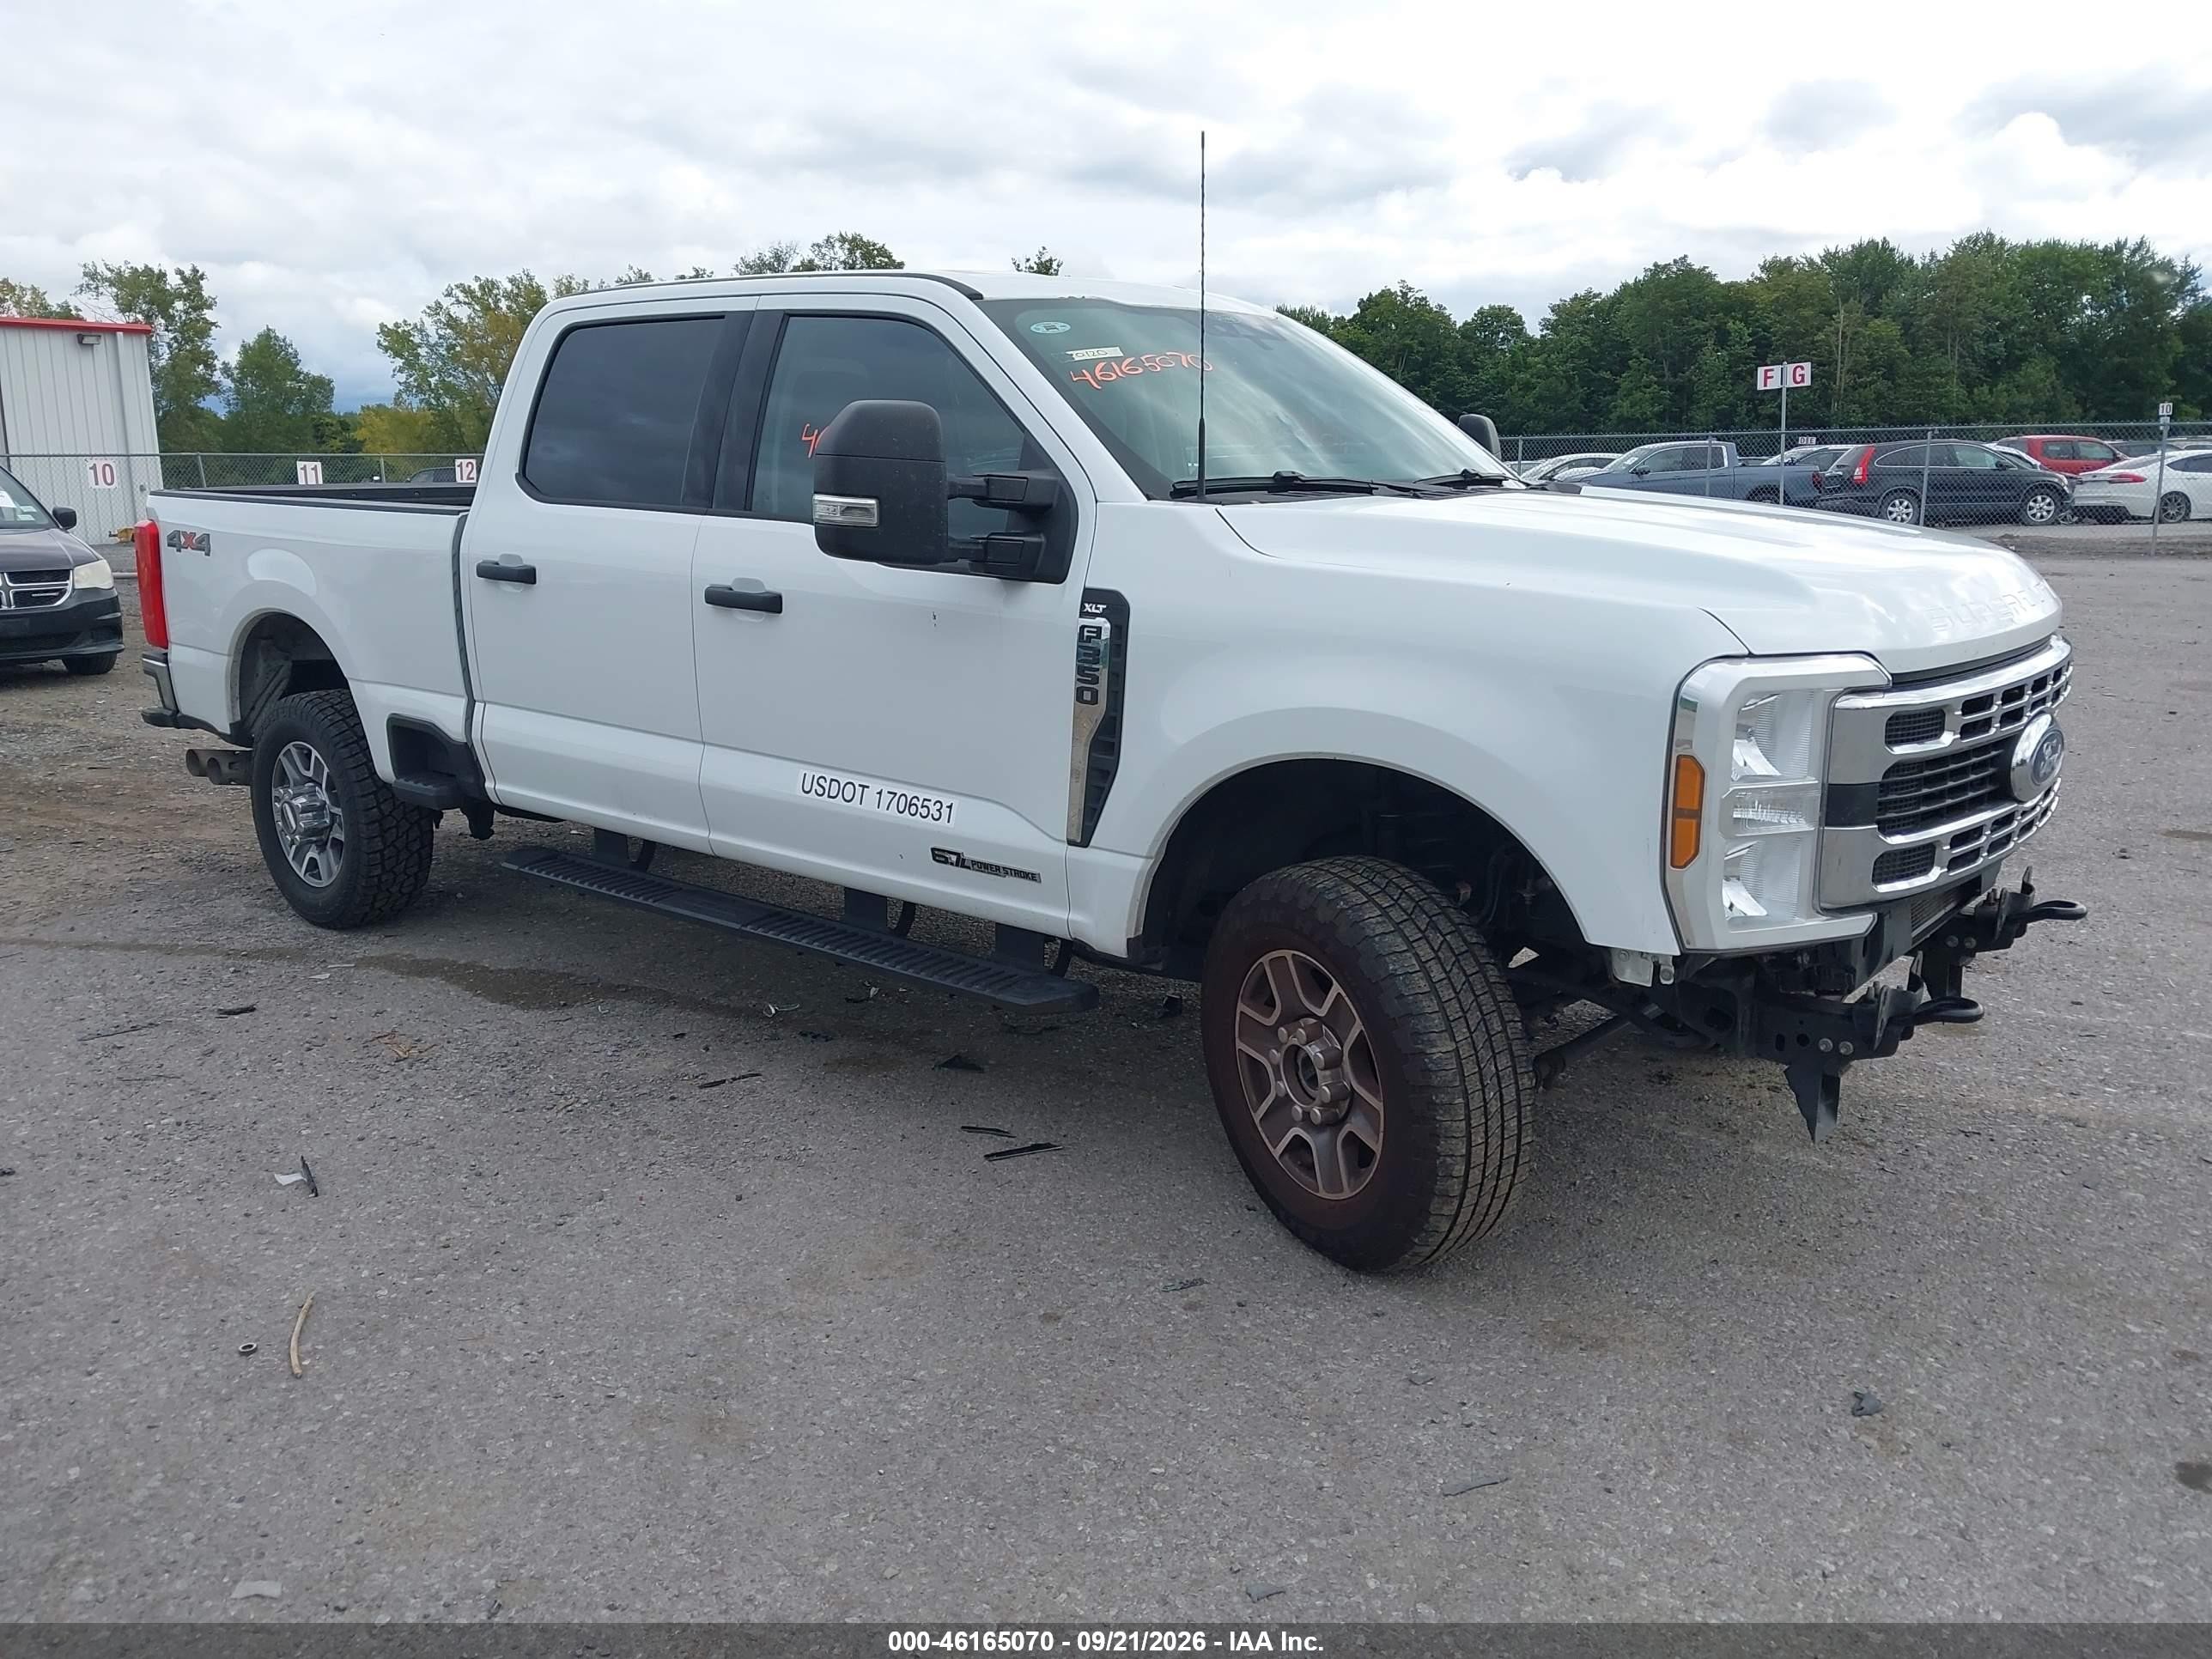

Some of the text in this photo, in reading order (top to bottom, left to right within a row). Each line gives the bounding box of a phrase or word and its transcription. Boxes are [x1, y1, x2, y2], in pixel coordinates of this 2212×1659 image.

[1070, 351, 1213, 390] 46165070
[1763, 368, 1775, 388] F
[1792, 365, 1806, 385] G
[2160, 404, 2172, 414] 10
[88, 463, 115, 486] 10
[300, 464, 319, 485] 11
[457, 461, 475, 481] 12
[1083, 603, 1107, 613] XLT
[801, 772, 954, 824] USDOT 1706531
[971, 860, 1001, 873] POWER
[1002, 866, 1037, 882] STROKE
